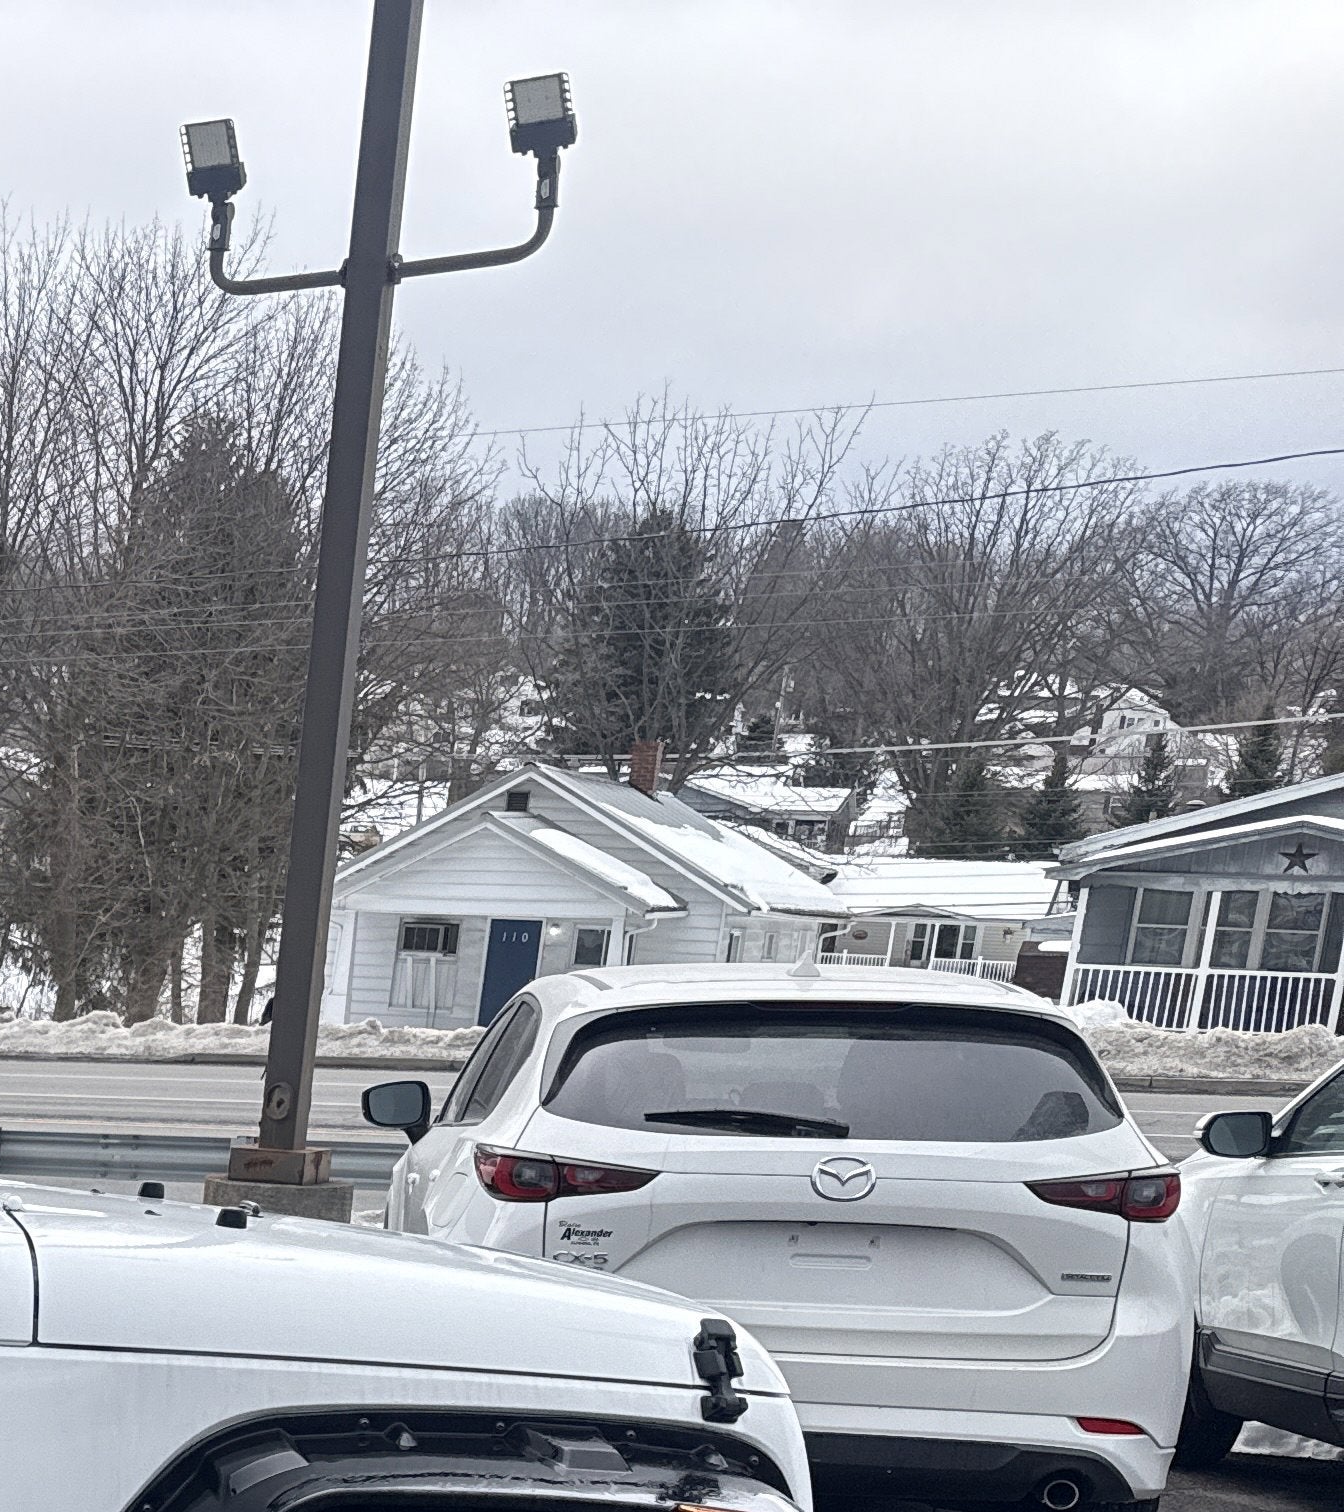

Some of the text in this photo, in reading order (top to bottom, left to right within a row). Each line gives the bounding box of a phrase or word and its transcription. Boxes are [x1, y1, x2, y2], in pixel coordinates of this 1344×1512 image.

[502, 931, 529, 943] 110
[560, 1228, 613, 1240] Alexander
[553, 1250, 608, 1264] CX-5
